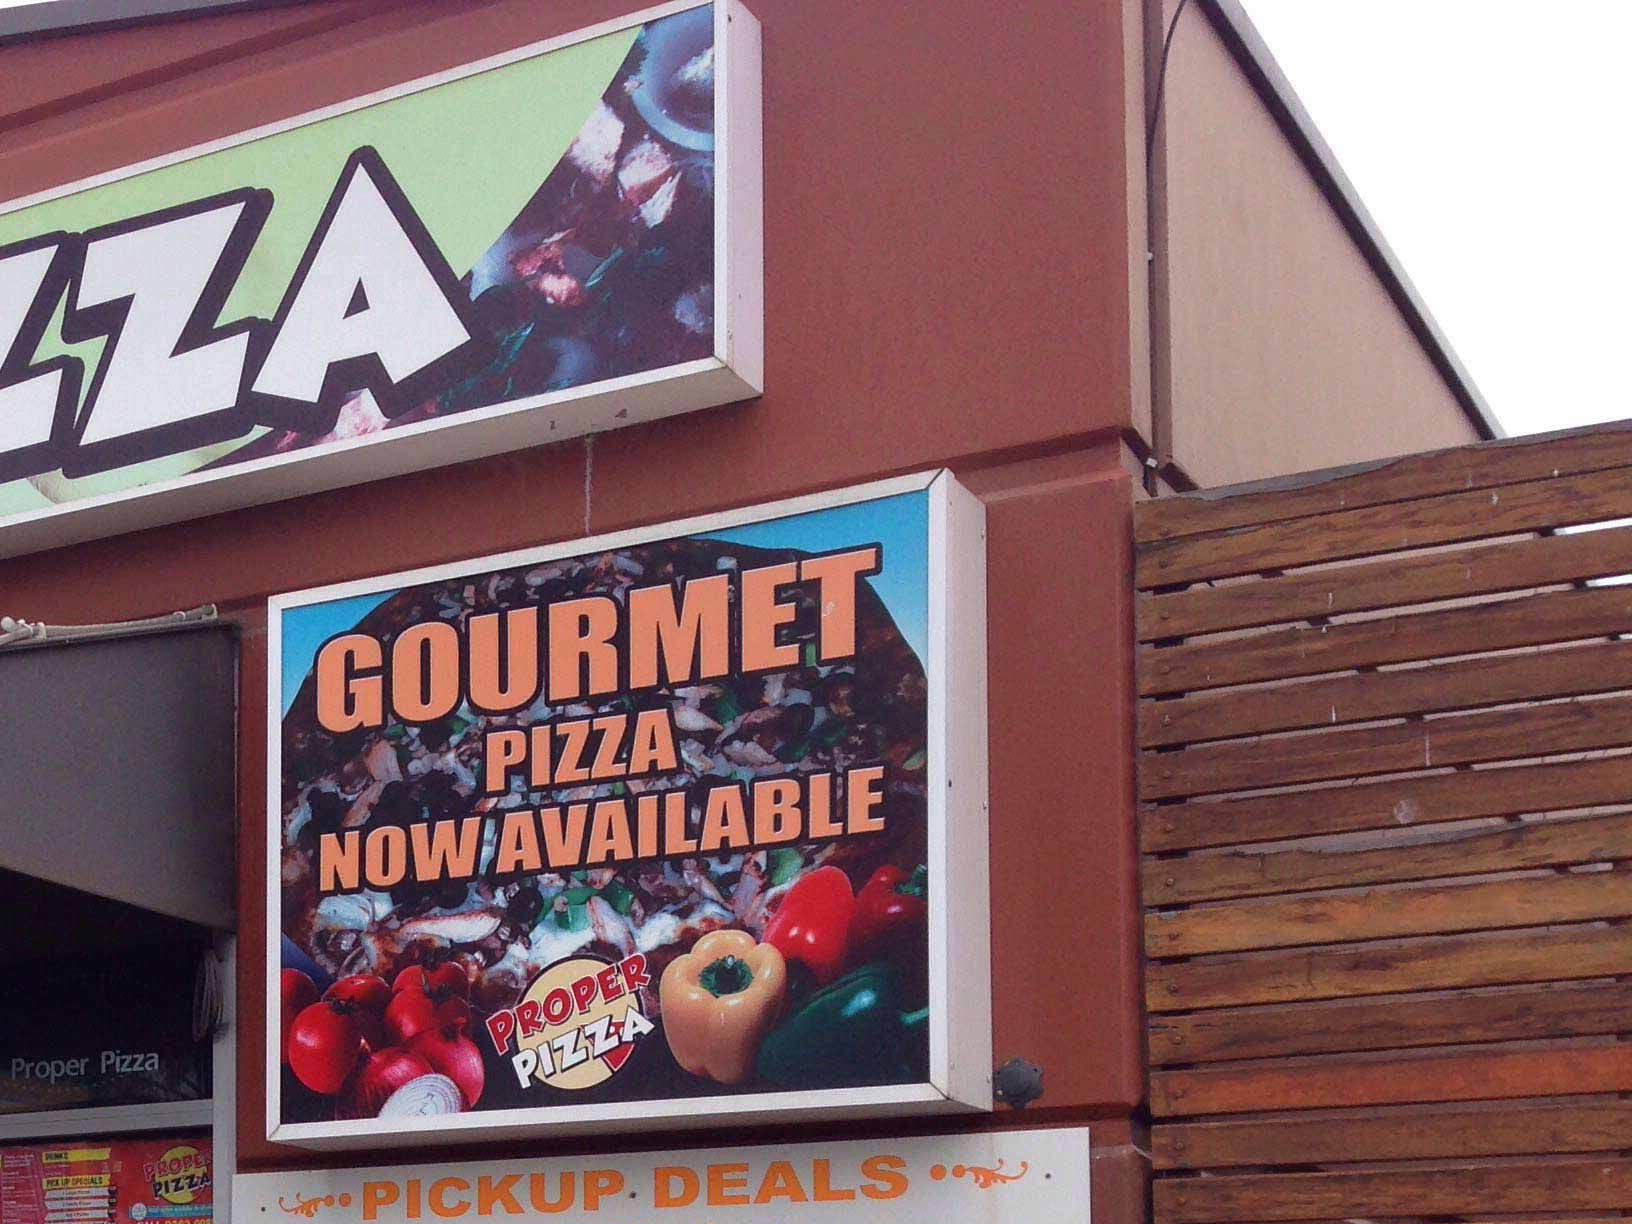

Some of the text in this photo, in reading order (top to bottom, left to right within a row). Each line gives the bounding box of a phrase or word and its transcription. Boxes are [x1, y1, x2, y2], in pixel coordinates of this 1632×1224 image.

[314, 547, 880, 735] GOURMET
[485, 707, 678, 792] PIZZA
[318, 765, 886, 893] NOW AVAILABLE
[485, 952, 651, 1056] PROPER
[11, 1055, 91, 1084] Proper
[100, 1049, 161, 1075] Pizza
[511, 1005, 656, 1089] PIZZA
[153, 1174, 212, 1201] PIZZA
[361, 1154, 910, 1221] PICKUP DEALS
